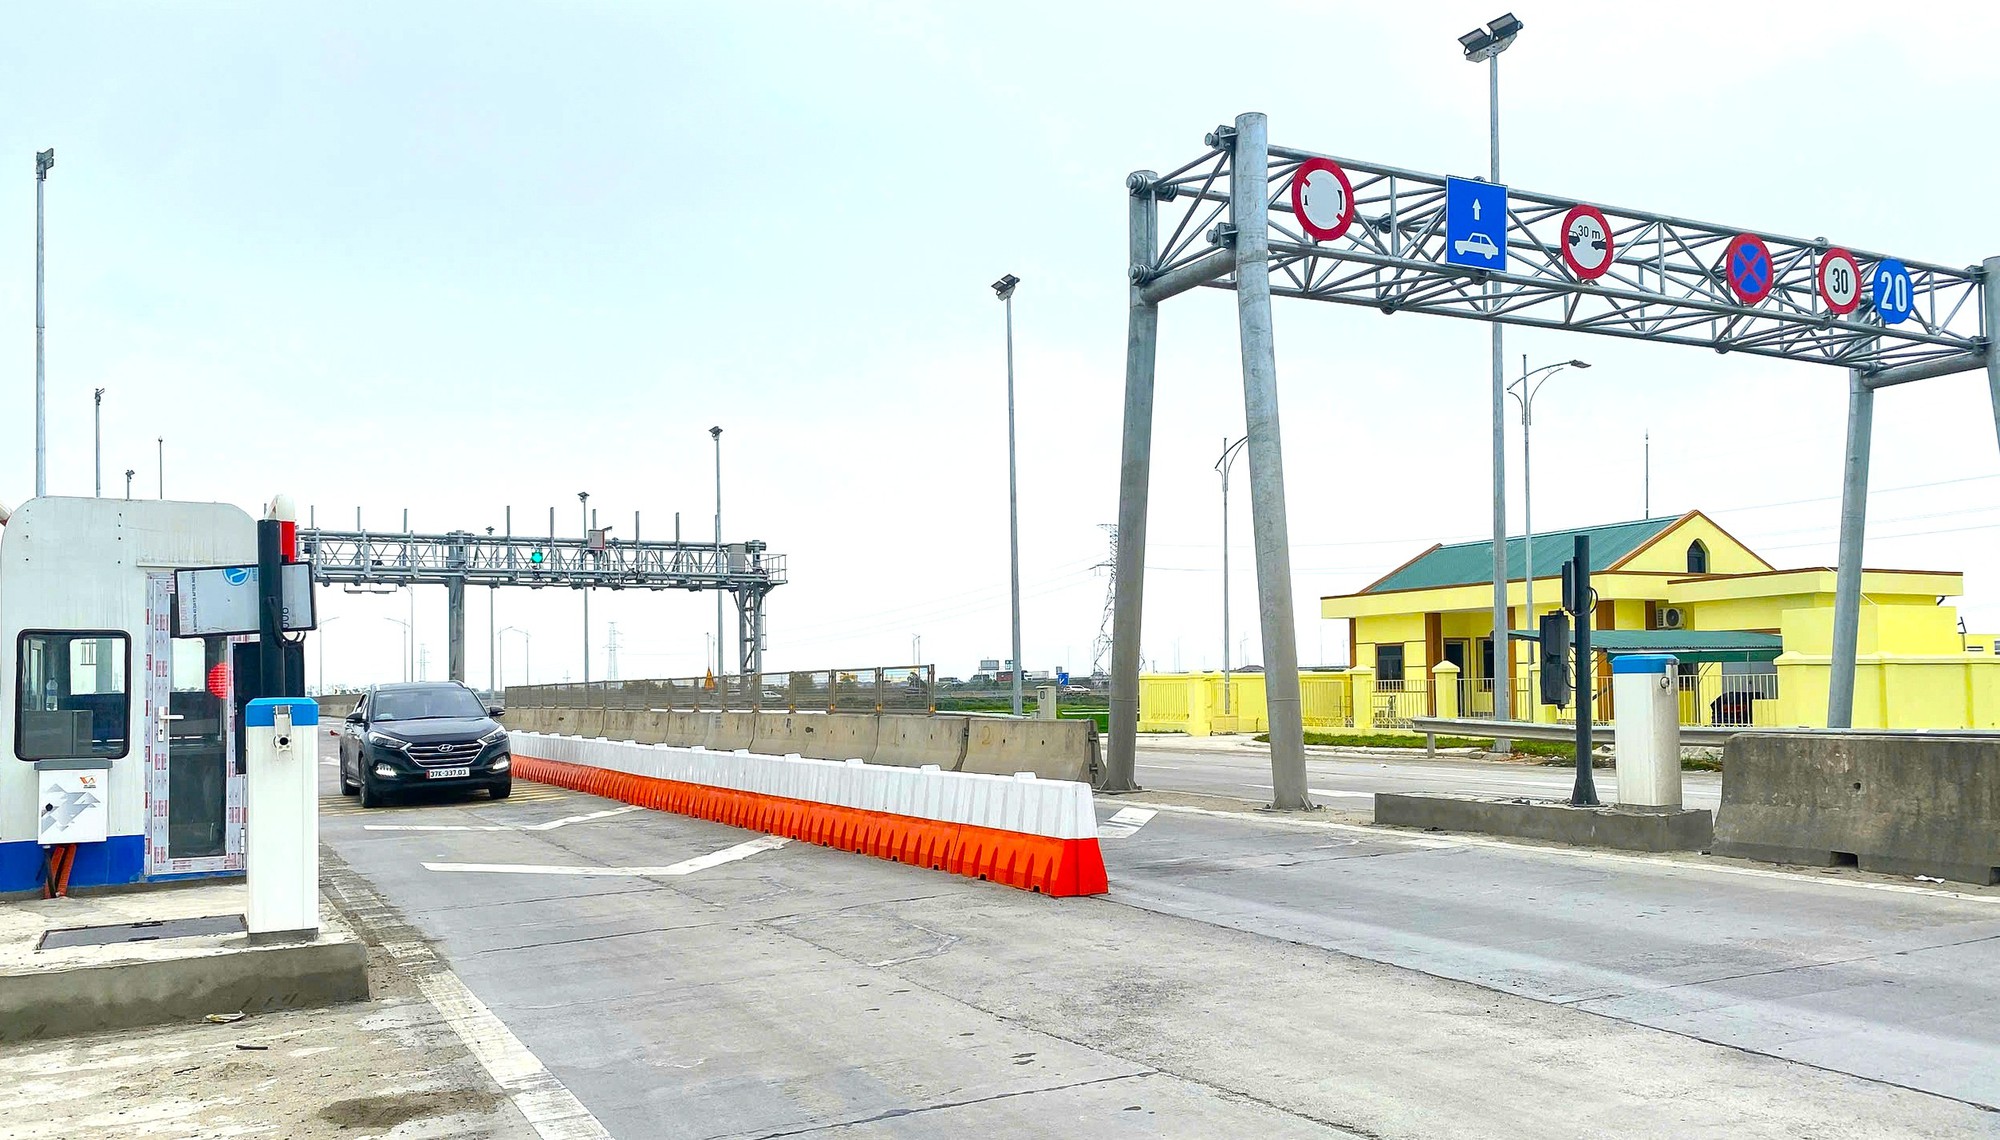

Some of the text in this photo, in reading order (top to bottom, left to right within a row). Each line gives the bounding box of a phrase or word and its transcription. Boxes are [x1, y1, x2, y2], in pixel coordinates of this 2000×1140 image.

[1578, 225, 1601, 240] 30 m
[1832, 267, 1849, 295] 30
[1879, 271, 1908, 313] 20
